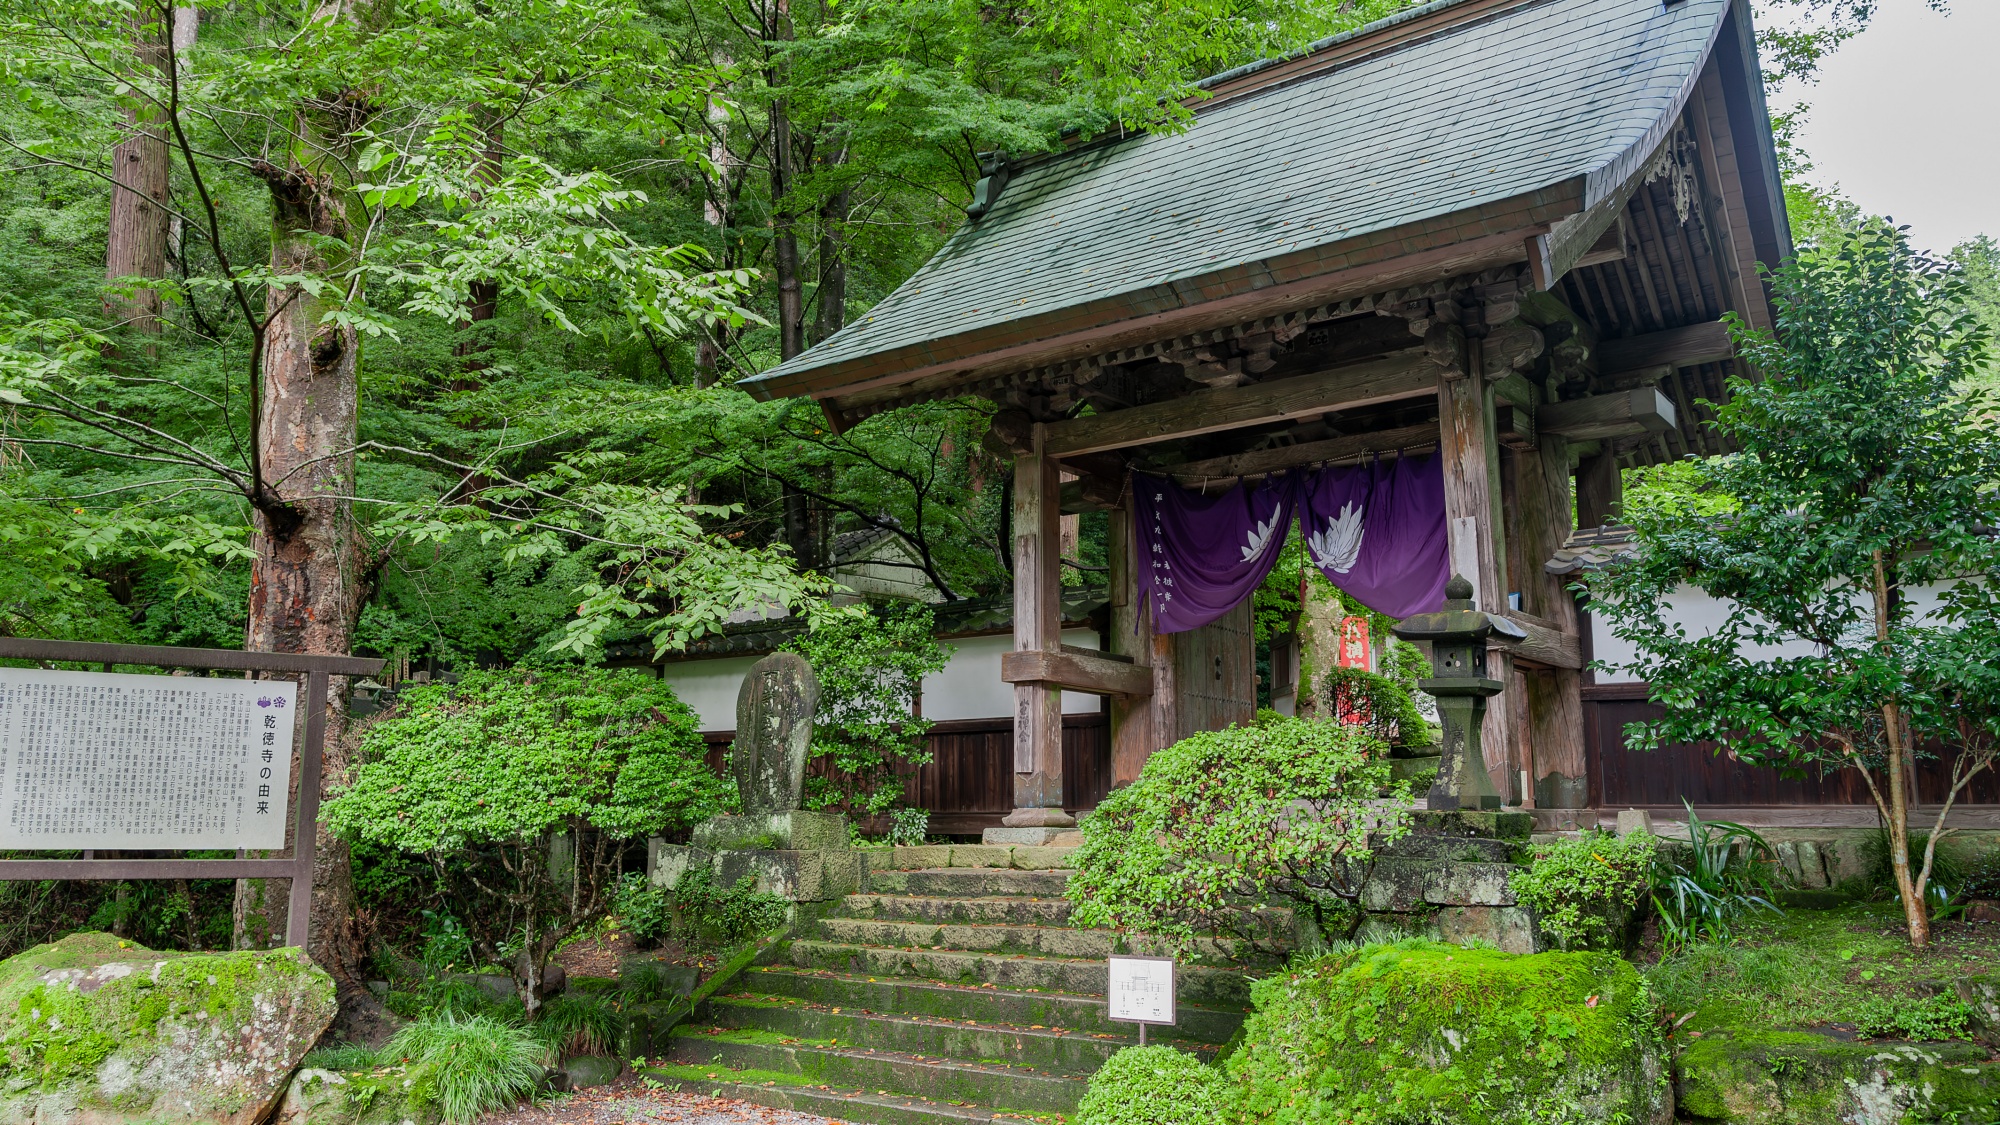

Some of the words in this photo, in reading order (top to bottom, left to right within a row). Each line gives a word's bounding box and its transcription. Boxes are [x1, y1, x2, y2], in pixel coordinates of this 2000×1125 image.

[256, 714, 277, 815] 乾徳寺の由来
